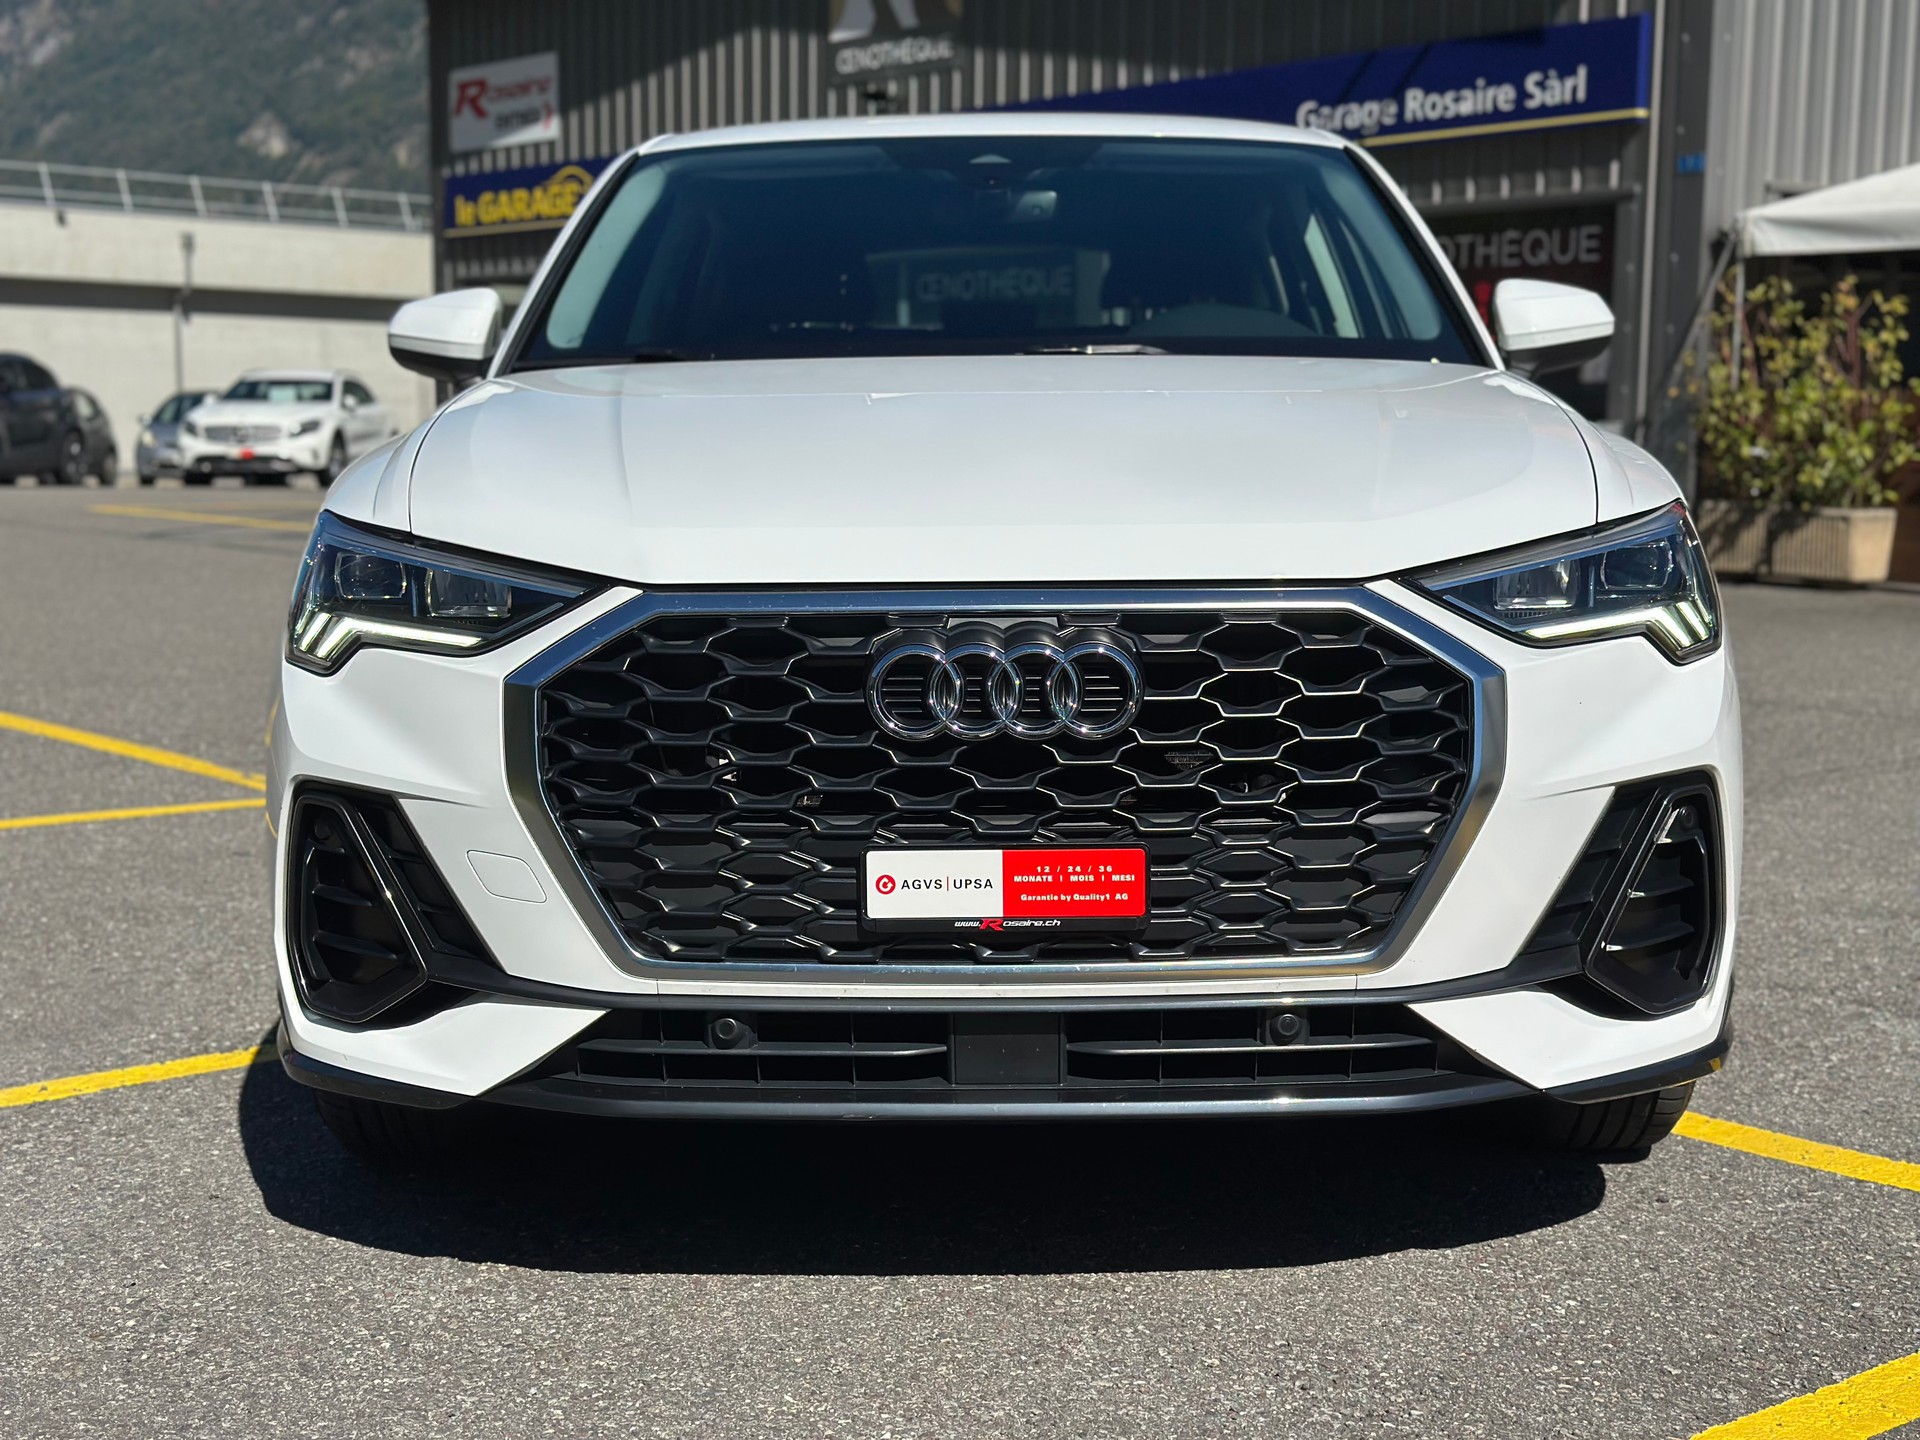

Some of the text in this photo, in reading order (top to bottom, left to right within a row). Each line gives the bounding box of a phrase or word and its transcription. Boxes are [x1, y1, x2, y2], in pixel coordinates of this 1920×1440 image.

[1295, 64, 1588, 135] Garage Rosaire Sàrl
[454, 180, 582, 227] le GARAGE
[901, 878, 994, 890] AGVS UPSA
[1060, 893, 1072, 902] by
[1073, 893, 1110, 902] Quality1
[954, 918, 1061, 931] www.Rosaire.ch
